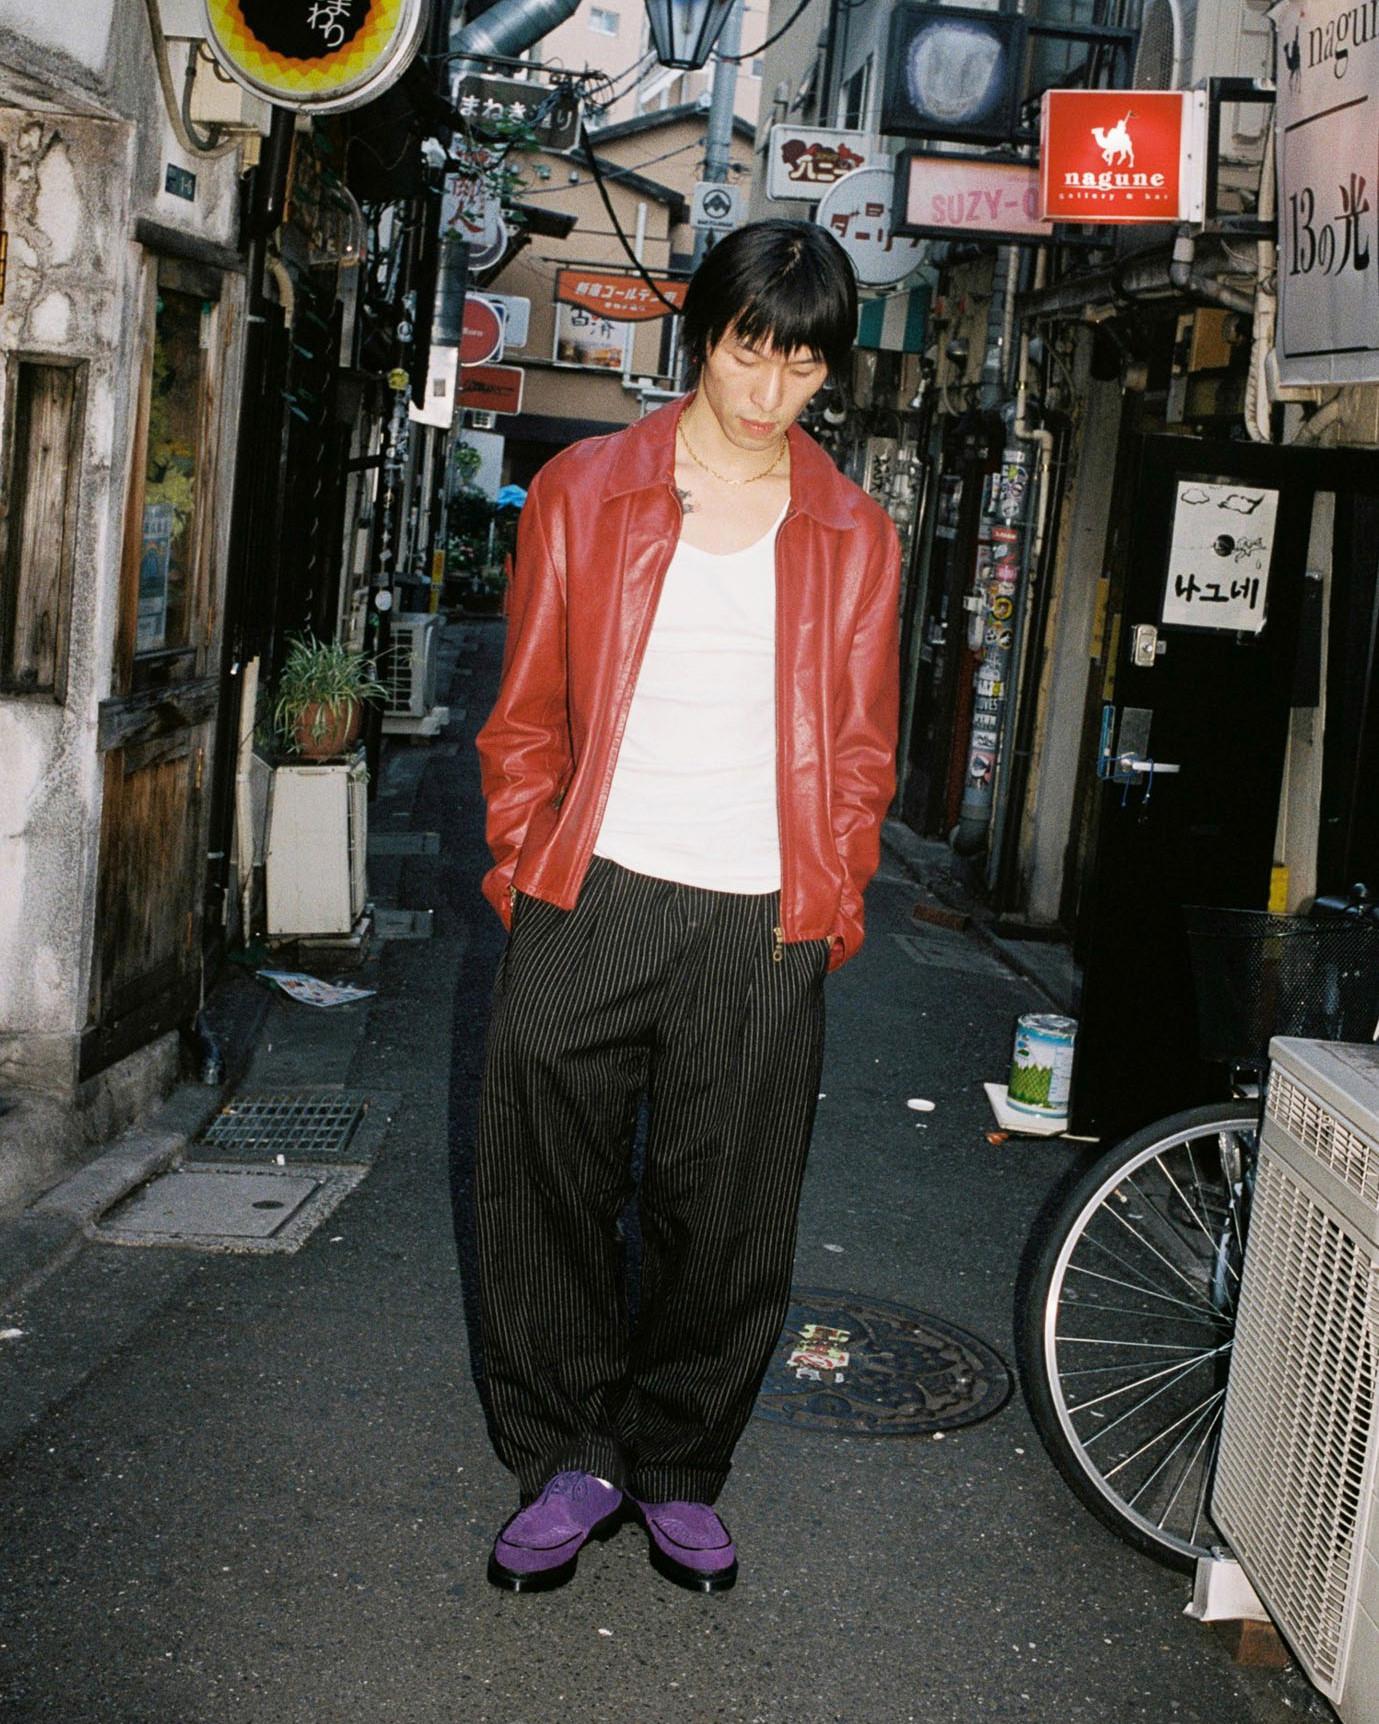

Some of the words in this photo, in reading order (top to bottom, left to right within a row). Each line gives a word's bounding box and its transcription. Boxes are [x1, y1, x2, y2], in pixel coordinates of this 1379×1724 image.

[1064, 171, 1166, 192] nagune
[1289, 172, 1371, 277] 13の光
[1175, 573, 1260, 610] 나그네
